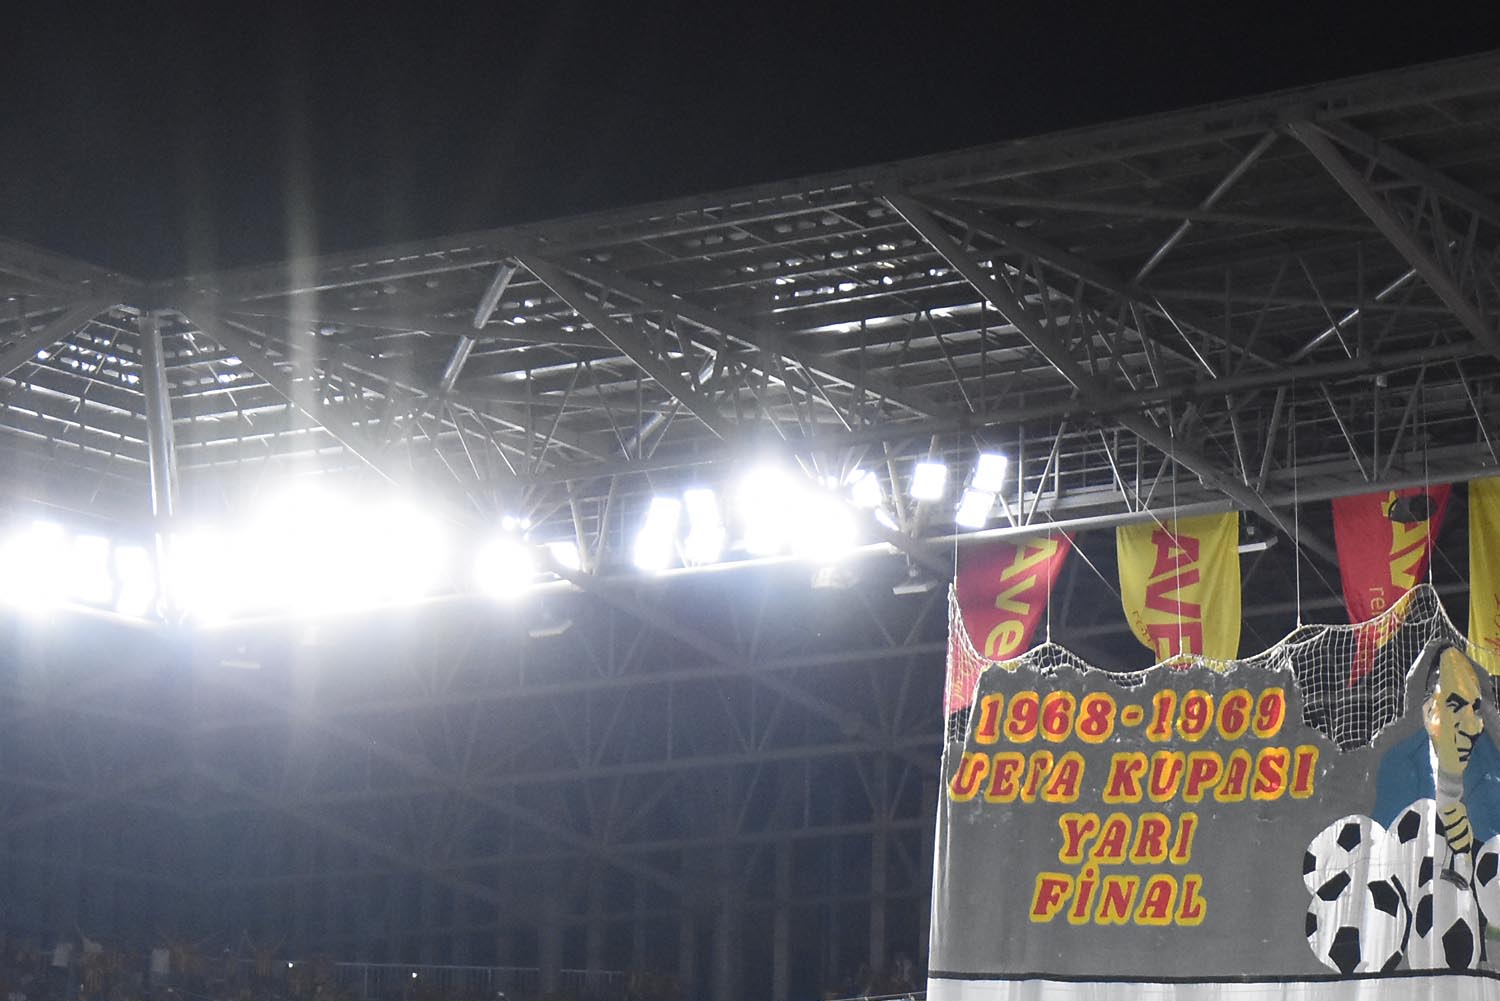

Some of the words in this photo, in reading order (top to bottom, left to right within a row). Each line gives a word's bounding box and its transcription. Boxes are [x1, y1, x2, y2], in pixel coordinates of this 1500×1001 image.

[984, 537, 1058, 657] Ave
[1103, 745, 1319, 803] KUPASI
[1059, 812, 1198, 864] YARI
[1030, 862, 1205, 926] FİNAL
